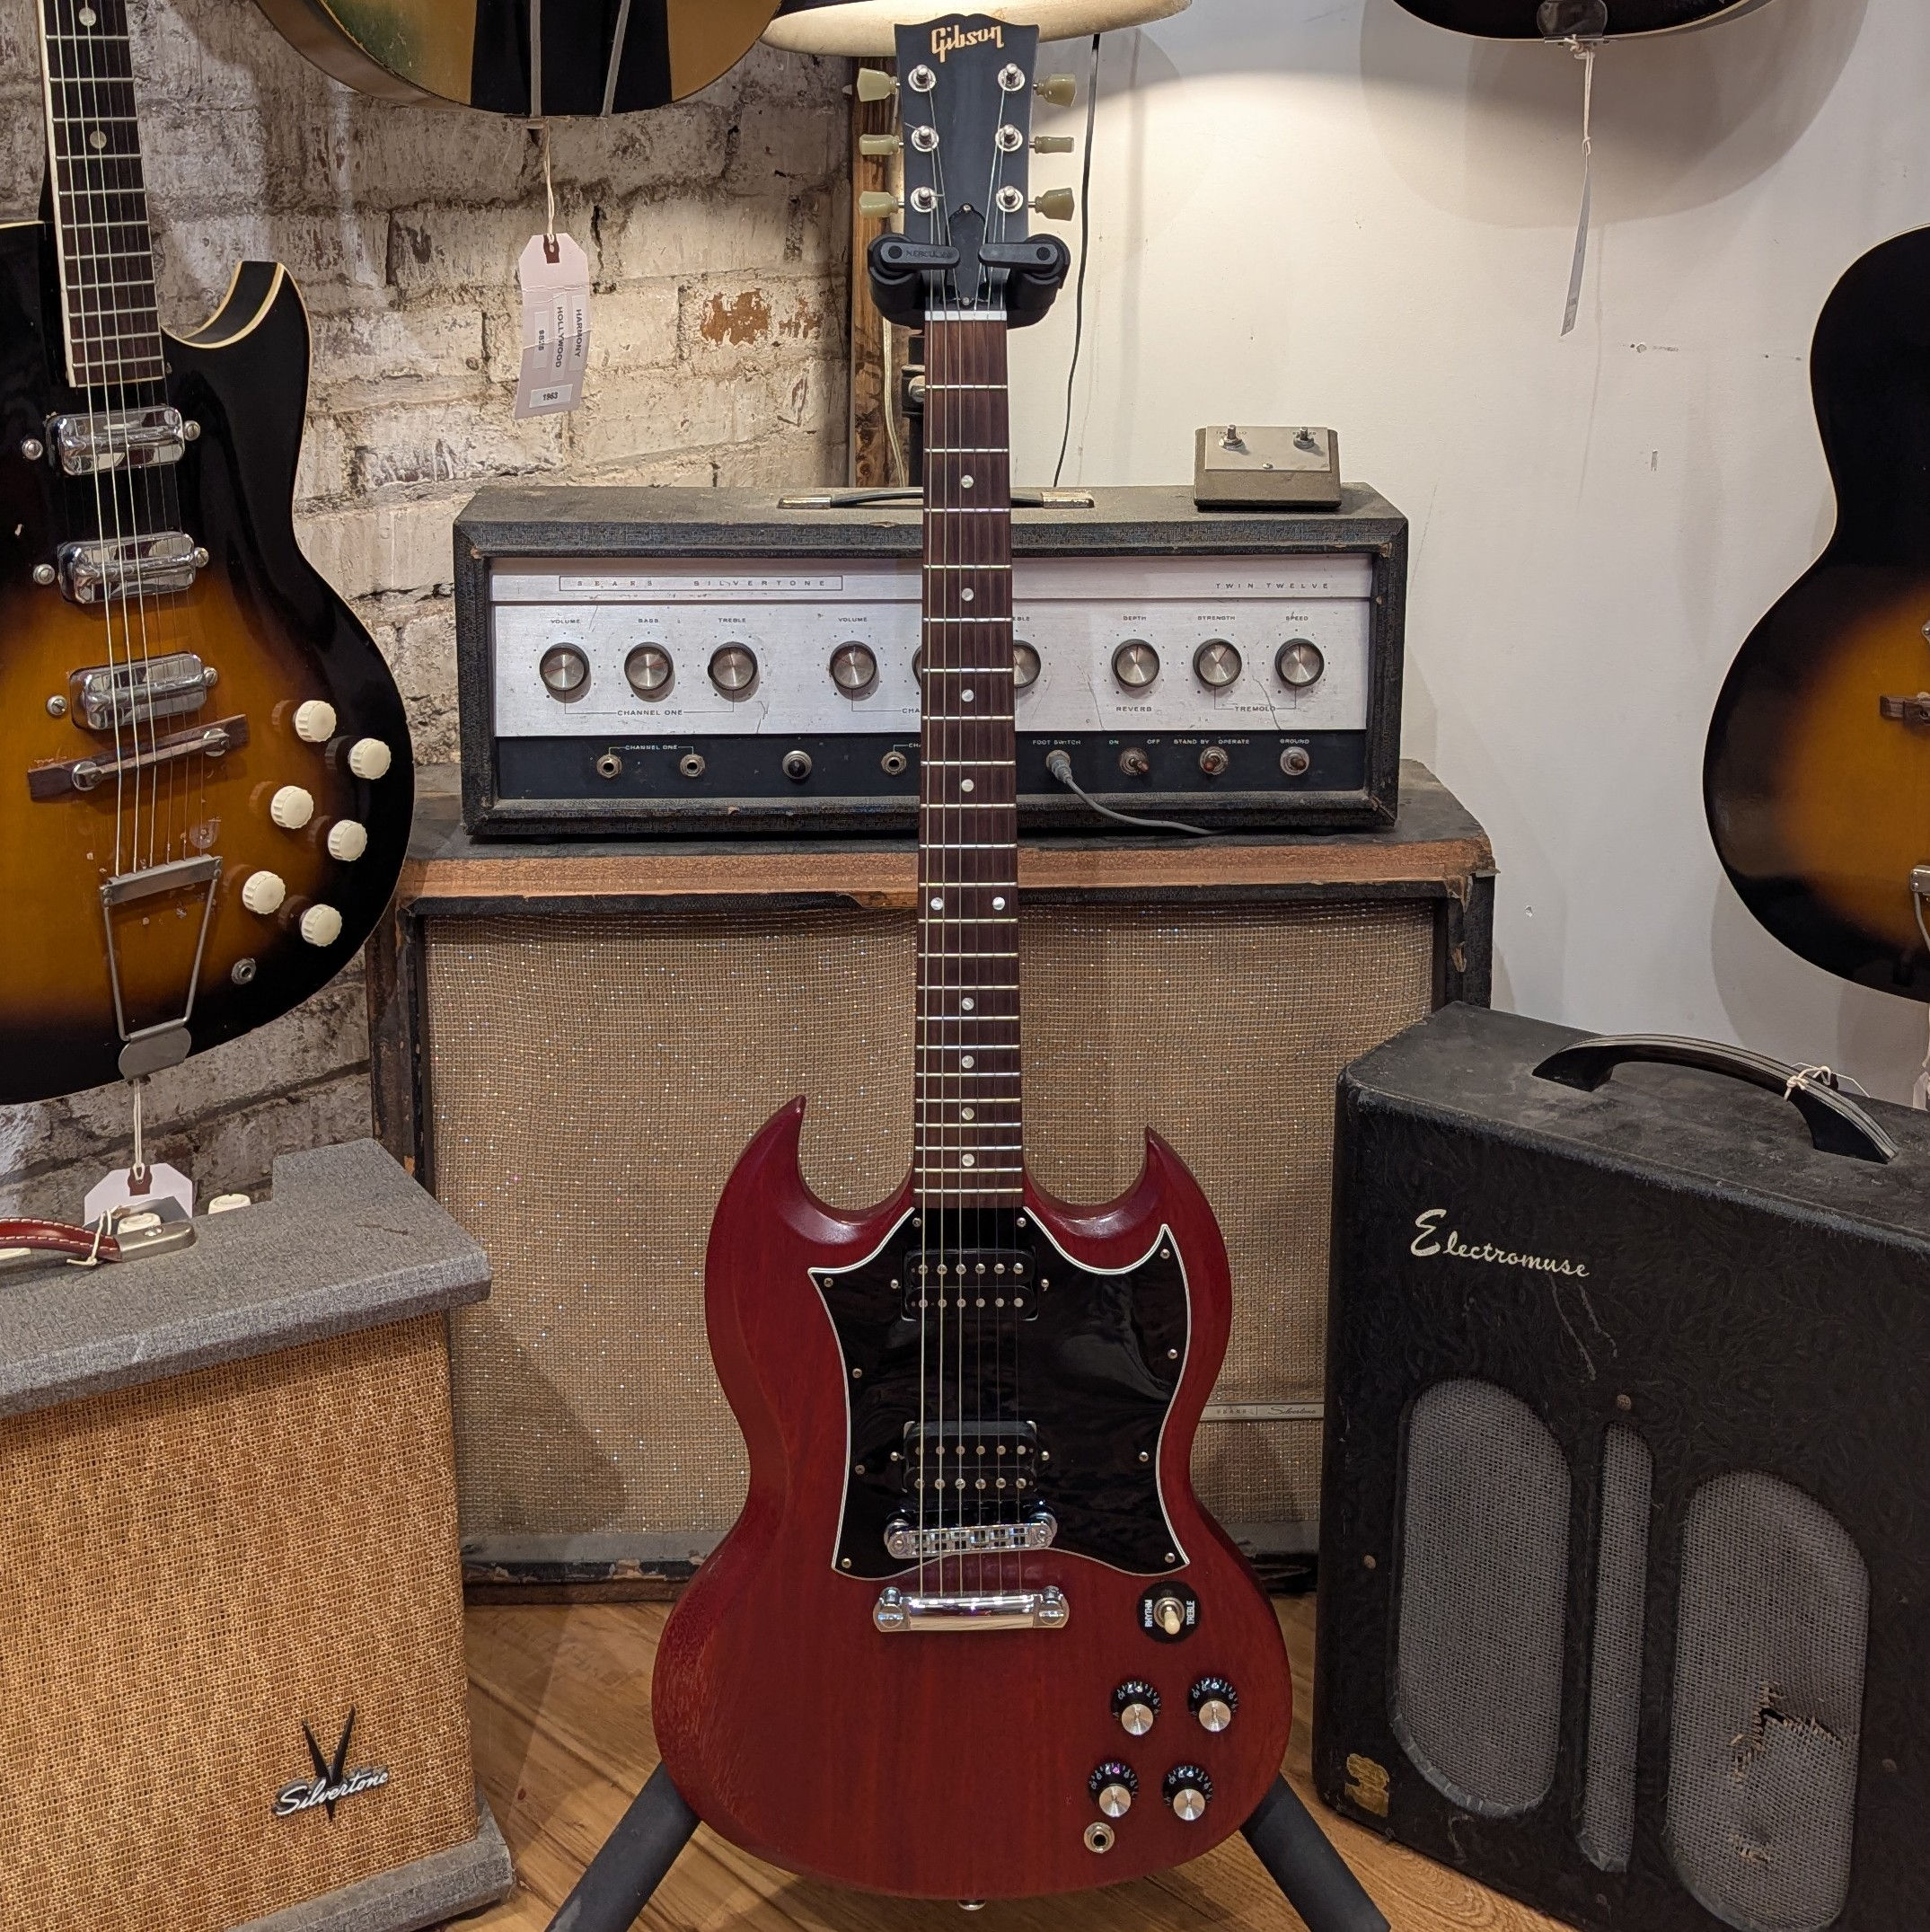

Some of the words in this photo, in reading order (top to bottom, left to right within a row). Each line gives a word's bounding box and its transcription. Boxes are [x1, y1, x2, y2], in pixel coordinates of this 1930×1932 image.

[930, 24, 1004, 63] Gibson
[555, 306, 565, 368] HOLLYWOOD
[575, 309, 583, 357] HARMONY
[1410, 1208, 1590, 1277] Electromuse
[1144, 1599, 1153, 1628] RHYTHM
[1186, 1600, 1195, 1626] TREBLE
[275, 1771, 389, 1816] Silvertone
